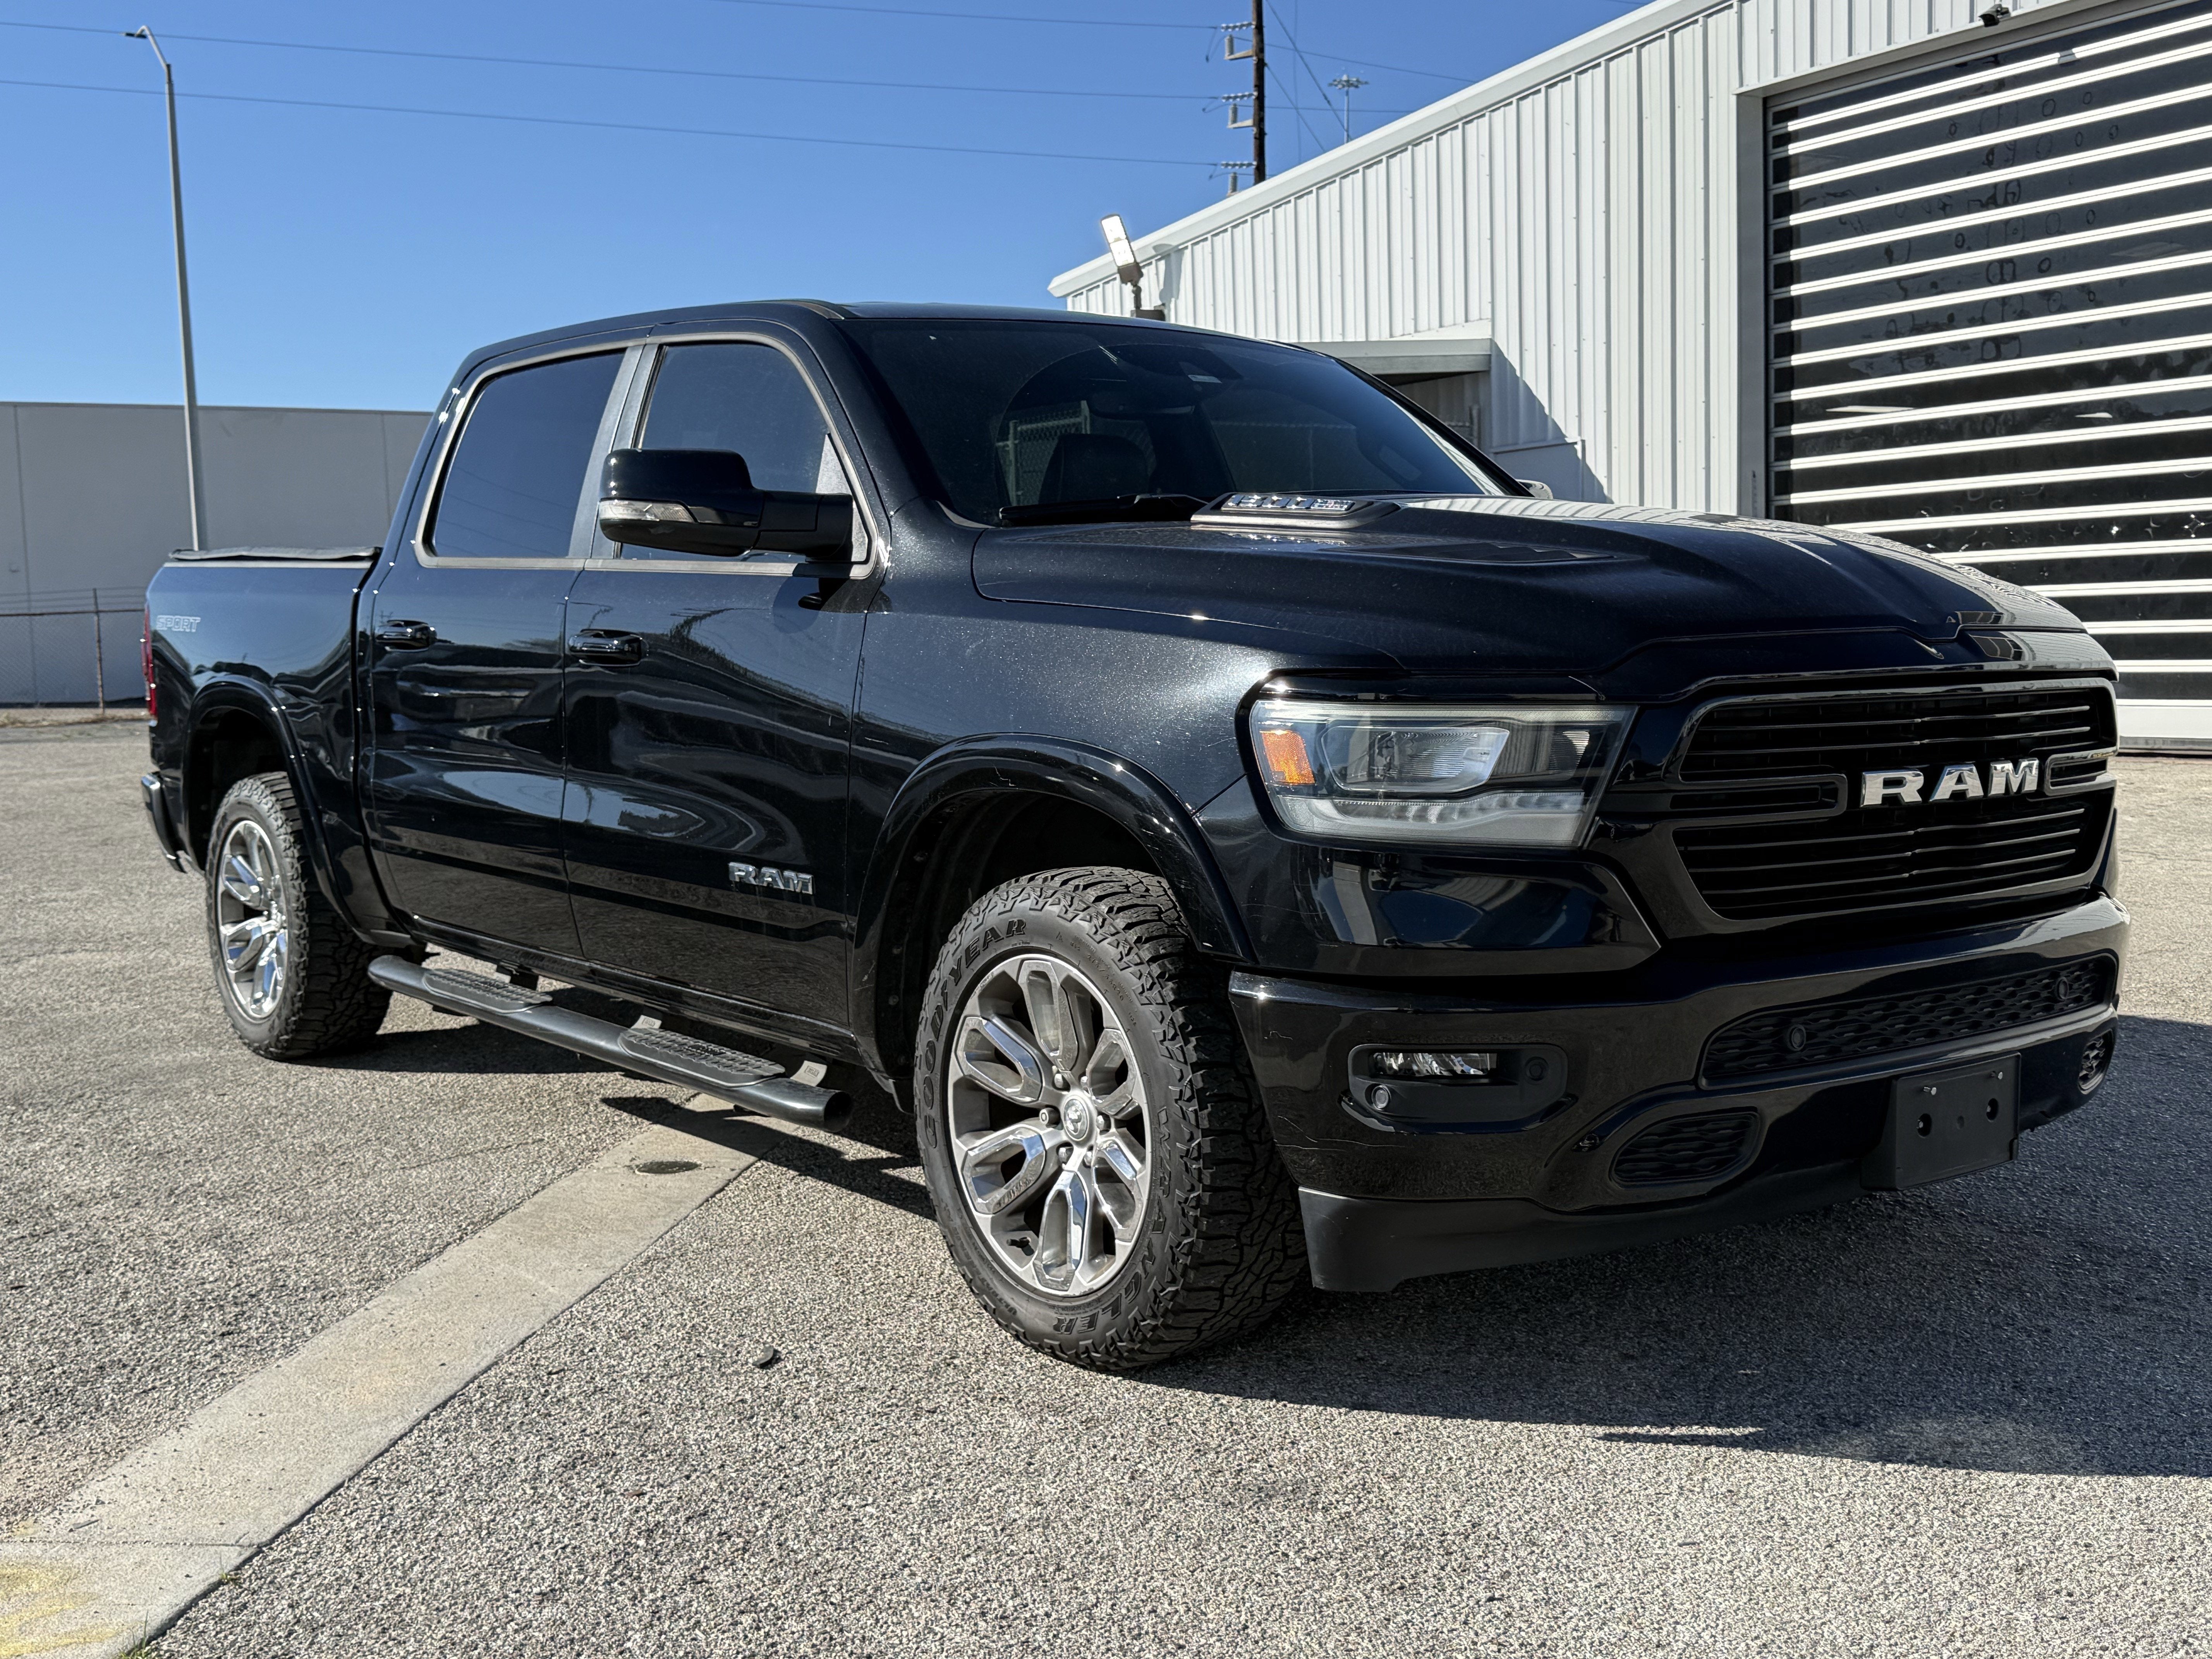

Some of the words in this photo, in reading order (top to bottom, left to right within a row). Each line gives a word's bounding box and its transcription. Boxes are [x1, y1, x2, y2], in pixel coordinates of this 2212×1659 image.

[156, 615, 201, 632] SPORT
[1860, 757, 2039, 807] RAM
[728, 862, 813, 895] RAM
[1053, 1106, 1171, 1335] WRANGLER
